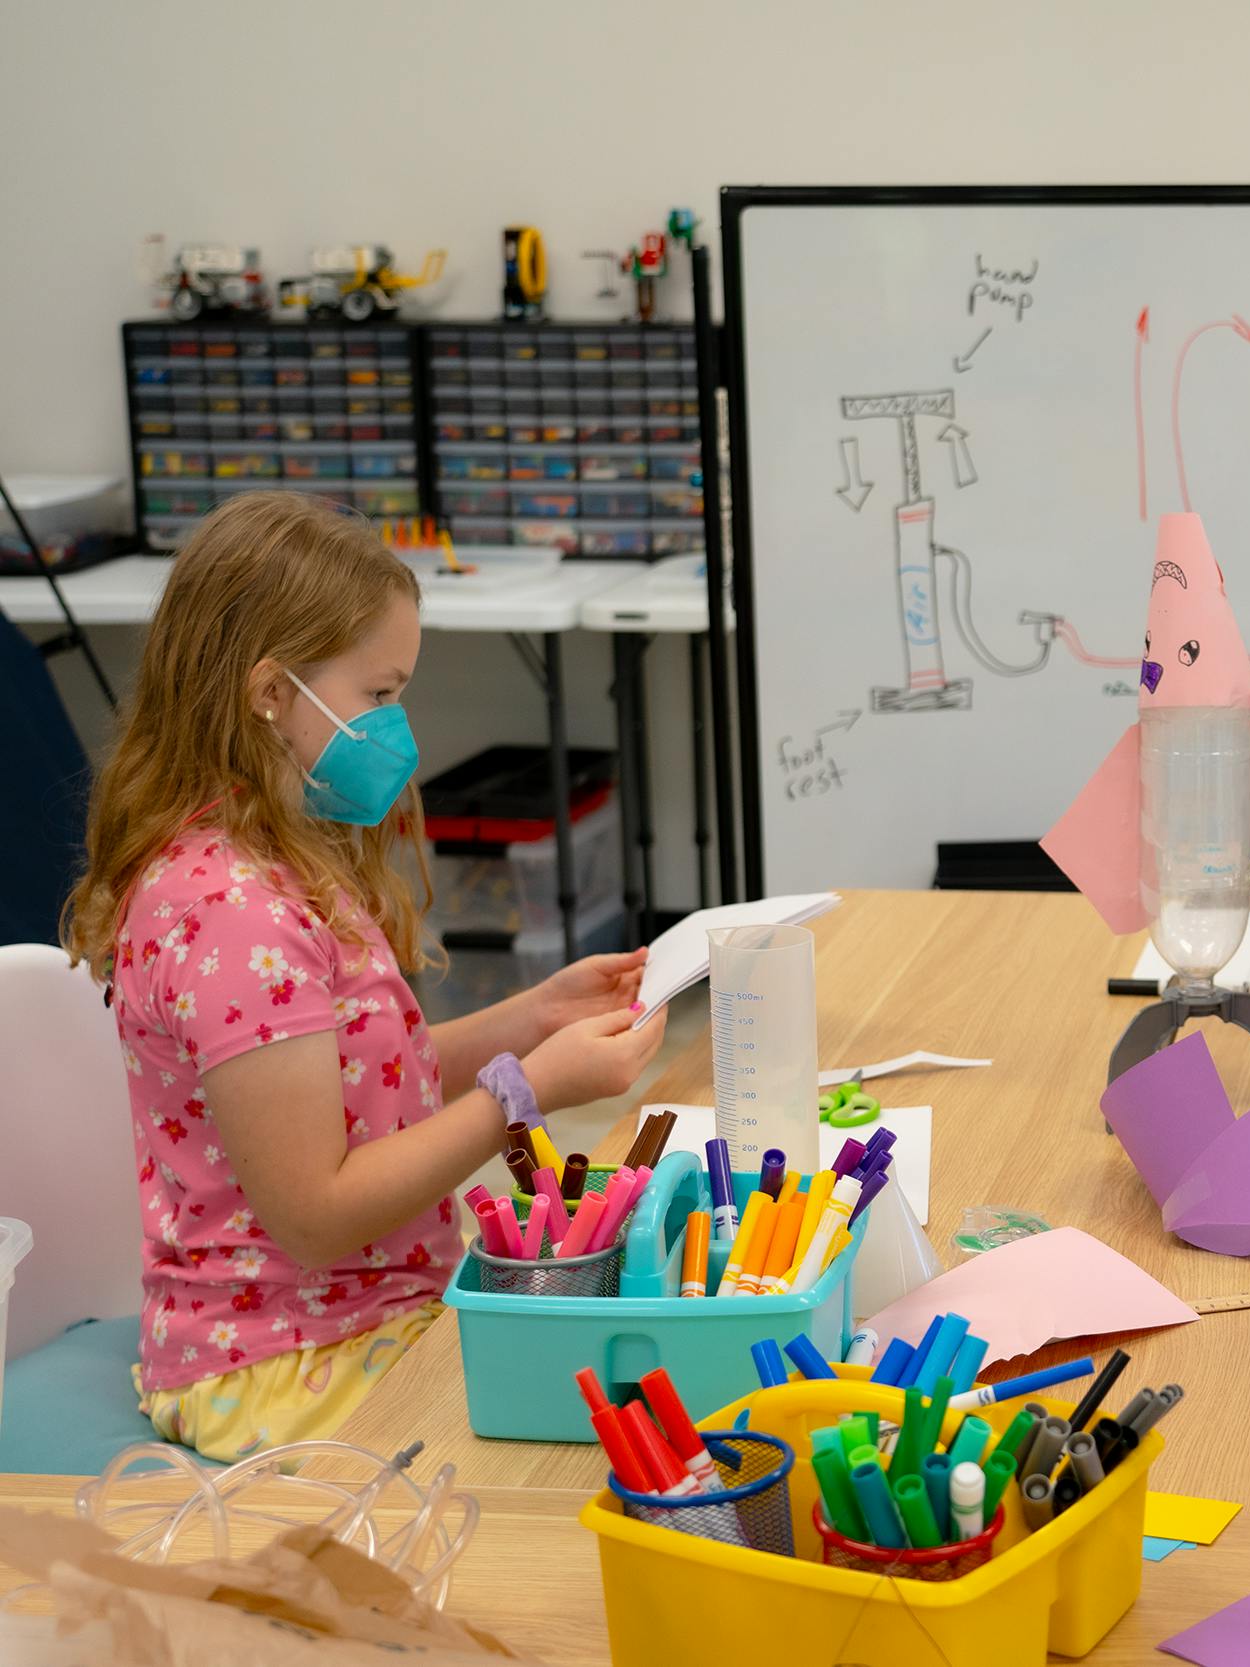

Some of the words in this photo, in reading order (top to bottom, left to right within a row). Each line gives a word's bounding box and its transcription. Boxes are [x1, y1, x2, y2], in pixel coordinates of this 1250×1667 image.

[975, 253, 1040, 284] hand
[966, 282, 1034, 322] pump
[776, 734, 824, 774] foot
[784, 757, 849, 801] rest
[741, 1118, 757, 1126] 250
[742, 1144, 758, 1152] 200
